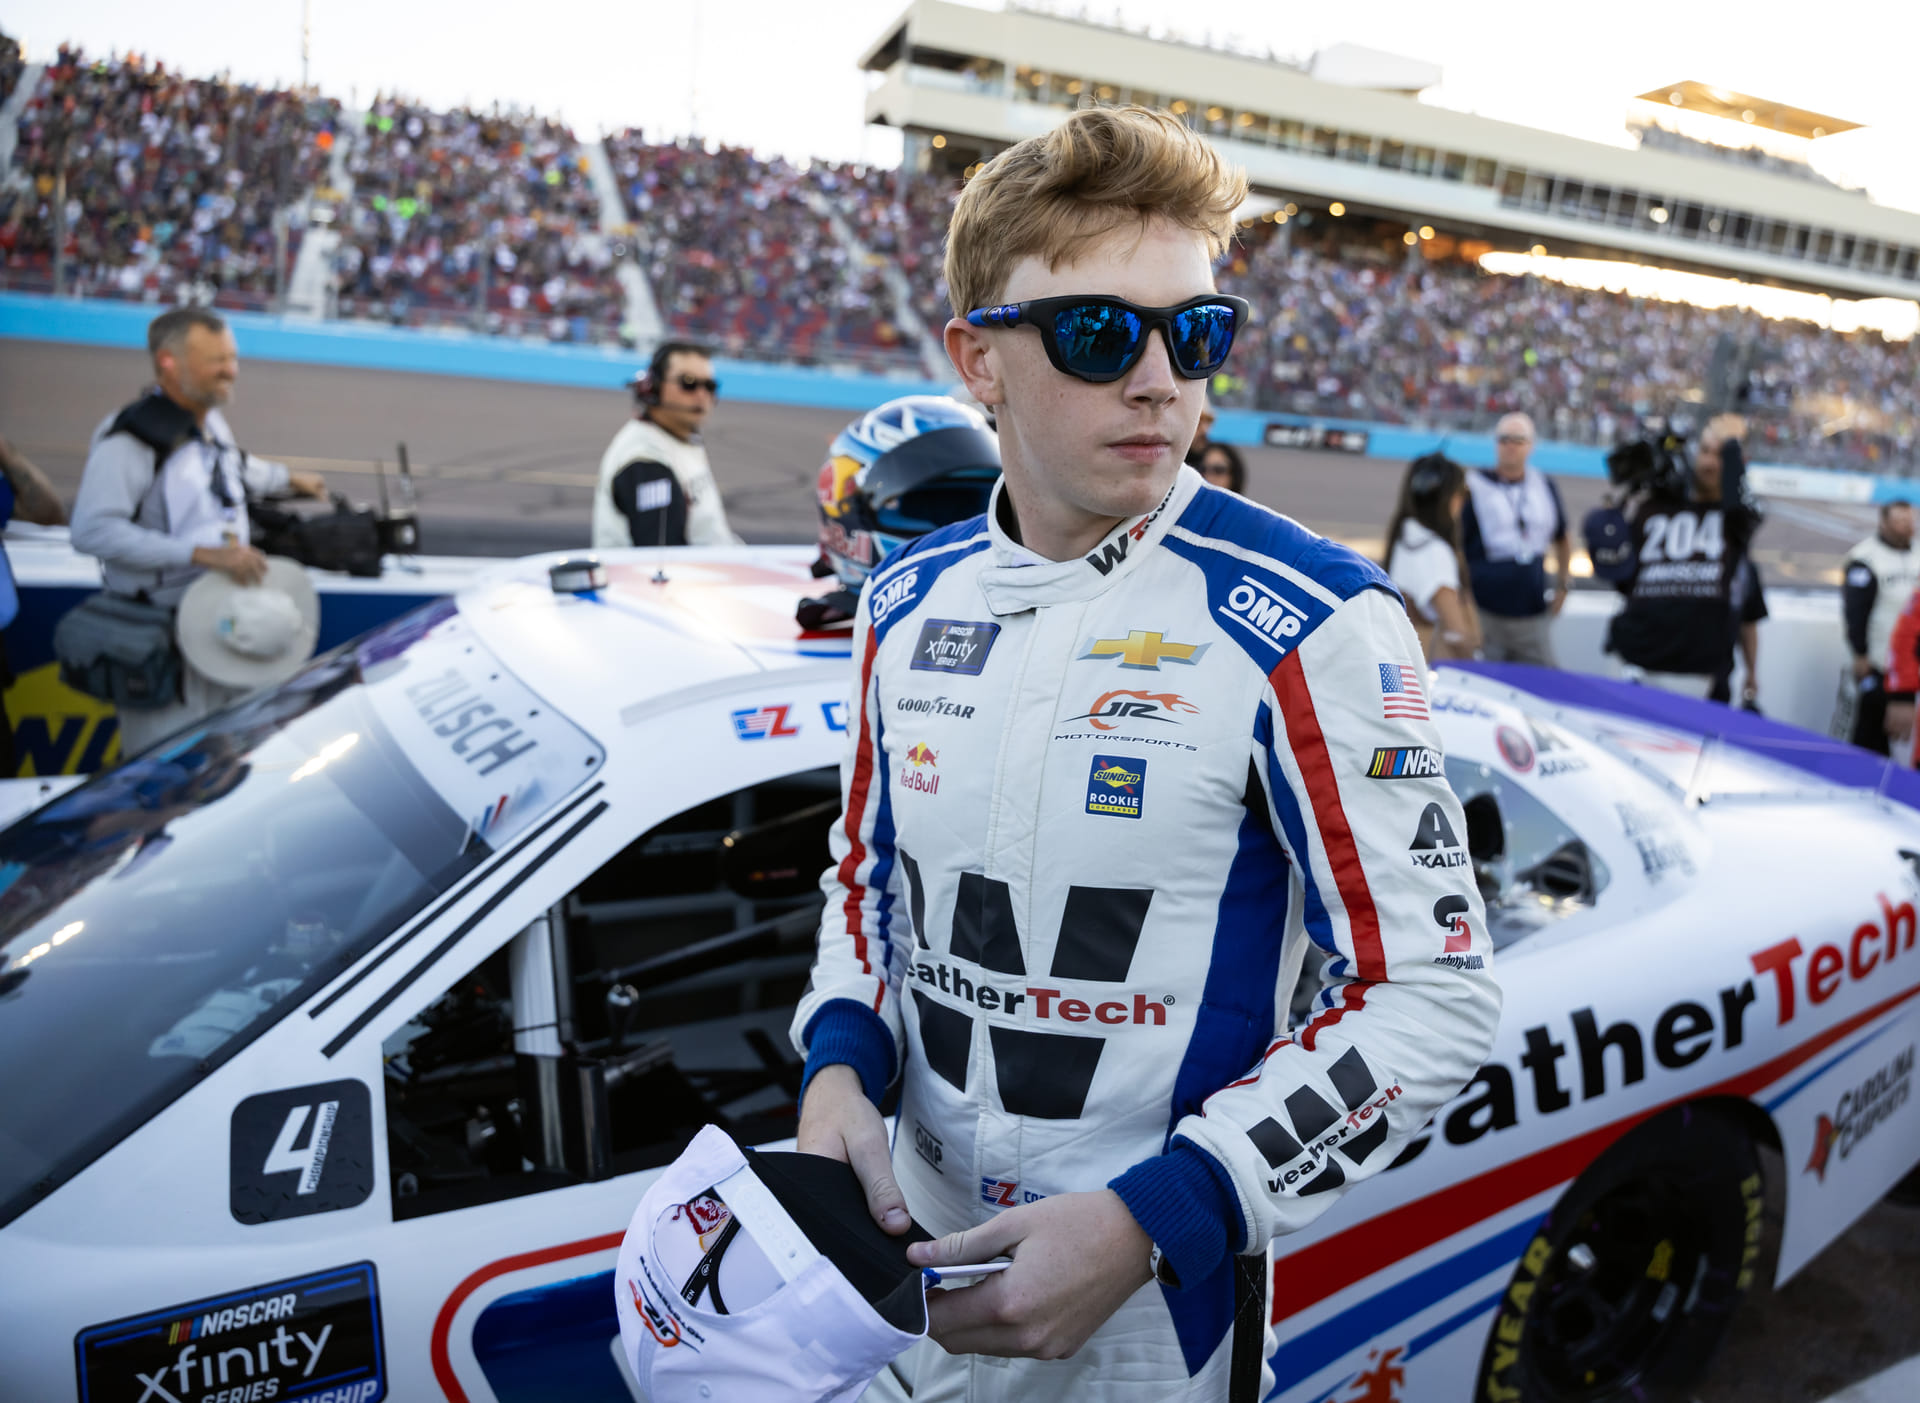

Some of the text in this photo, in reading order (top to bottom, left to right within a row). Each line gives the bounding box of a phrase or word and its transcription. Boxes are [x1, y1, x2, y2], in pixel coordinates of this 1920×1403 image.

[1638, 509, 1724, 561] 204
[873, 572, 918, 619] OMP
[1228, 585, 1301, 640] OMP
[925, 636, 978, 663] xfinity
[897, 697, 975, 719] GOODYEAR
[1054, 733, 1199, 752] MOTORSPORTS
[1402, 748, 1444, 776] NAS
[1095, 771, 1141, 784] SUNOCO
[1089, 792, 1139, 807] ROOKIE
[262, 1100, 340, 1195] 4
[915, 1126, 943, 1166] OMP
[1267, 1083, 1404, 1194] WeaherTech
[200, 1293, 297, 1338] NASCAR
[135, 1323, 334, 1403] xfinity
[200, 1378, 280, 1403] SERIES
